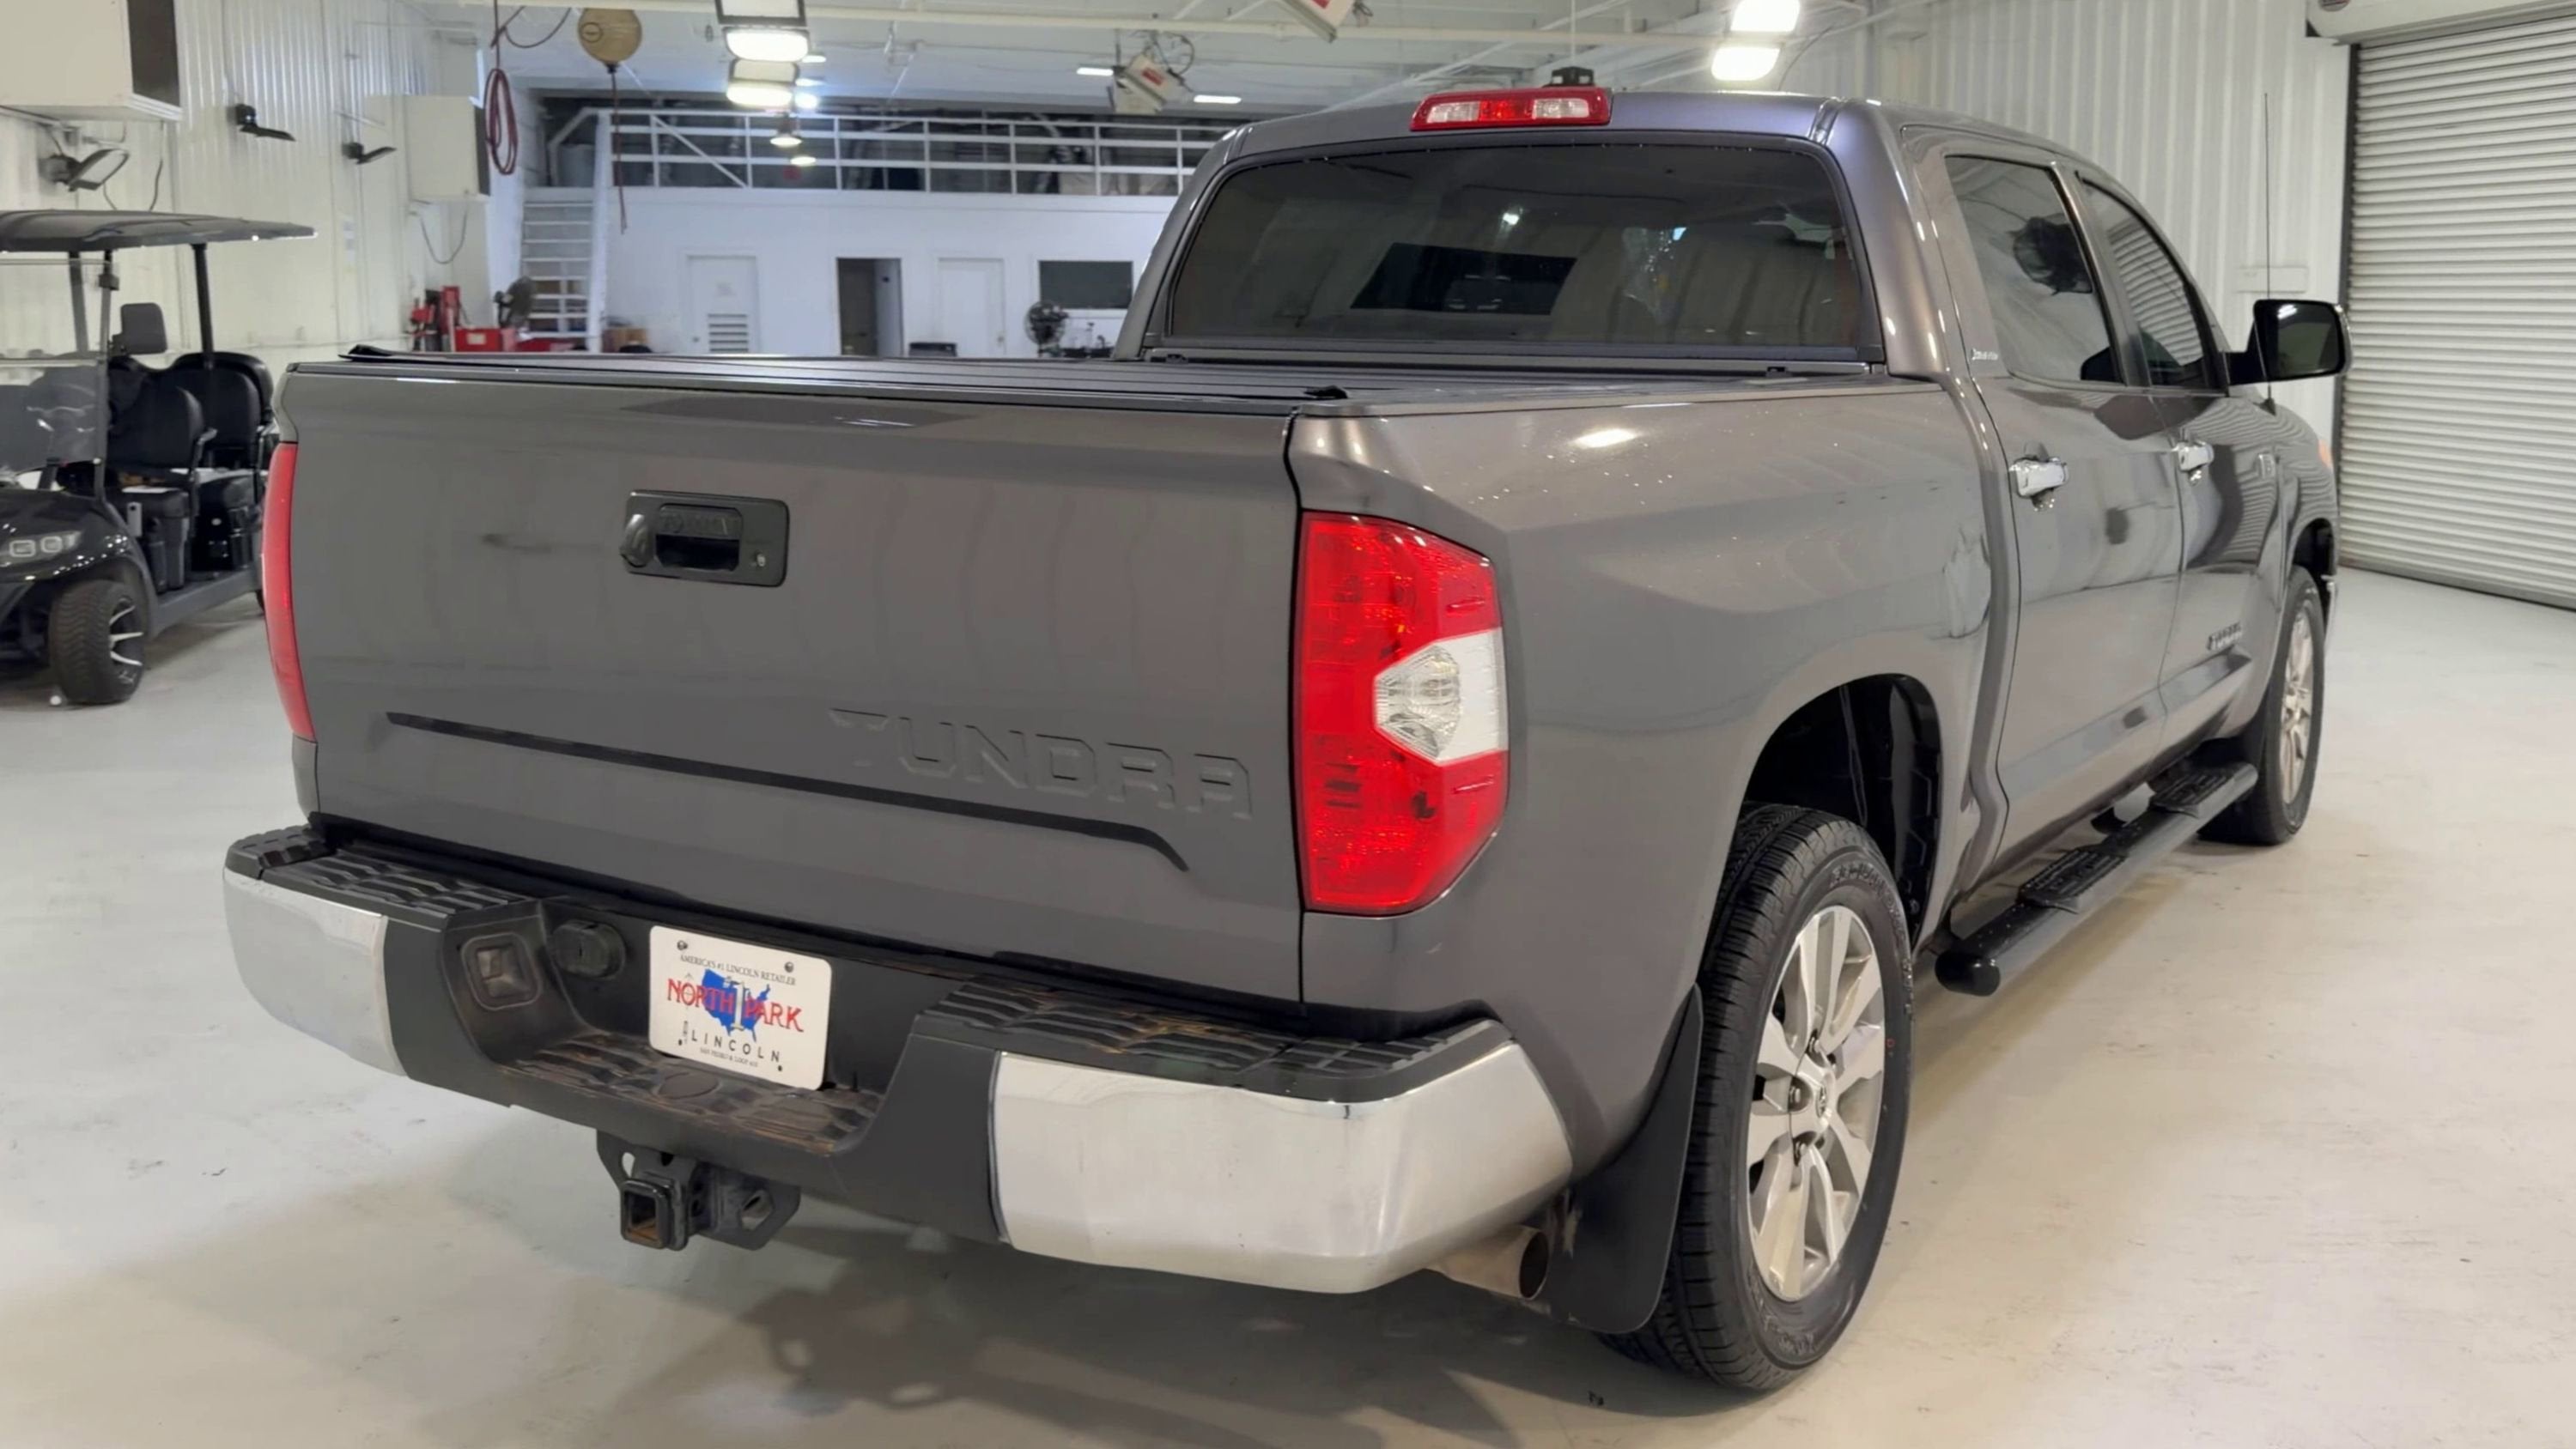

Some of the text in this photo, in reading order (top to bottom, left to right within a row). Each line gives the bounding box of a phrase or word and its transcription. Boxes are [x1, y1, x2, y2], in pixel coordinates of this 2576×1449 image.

[829, 707, 1252, 820] TUNDRA
[726, 965, 759, 977] LINCOLN
[762, 972, 796, 985] RETAILER
[667, 979, 804, 1033] NORTH PARK
[691, 1029, 781, 1063] LINCOLN
